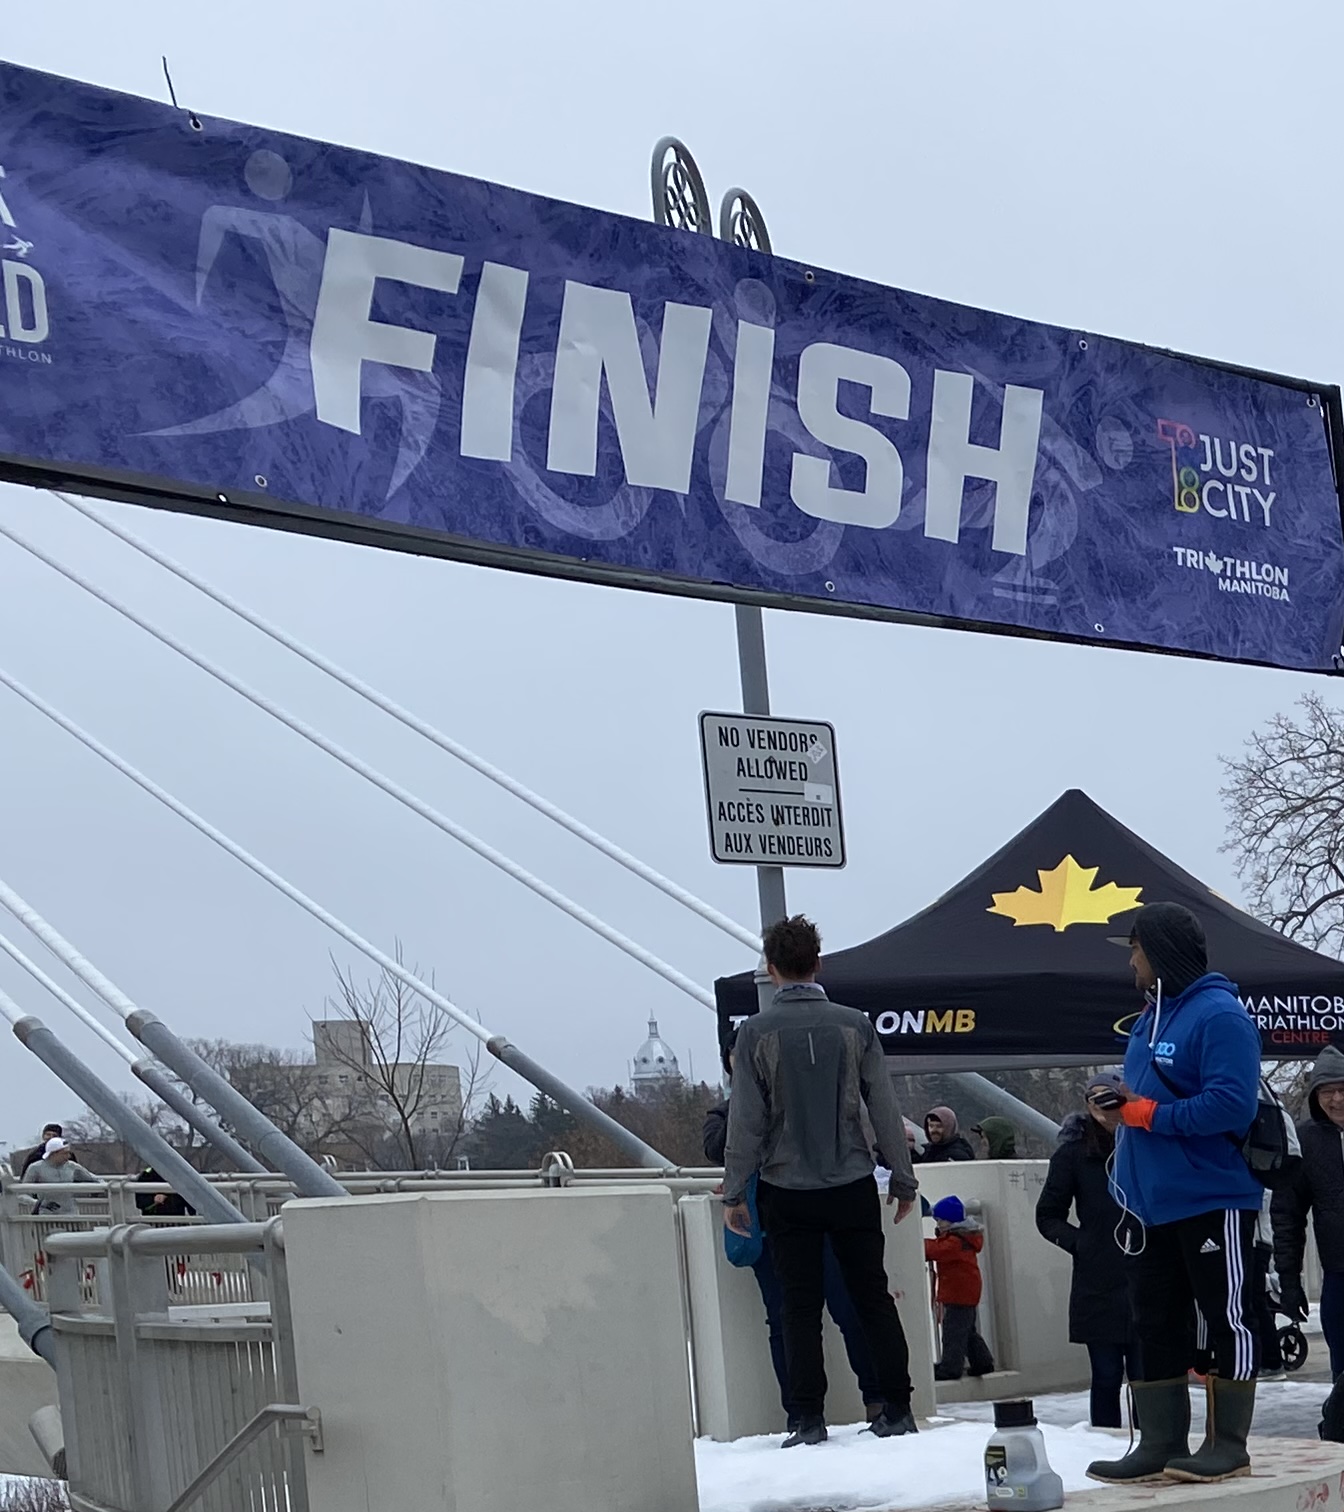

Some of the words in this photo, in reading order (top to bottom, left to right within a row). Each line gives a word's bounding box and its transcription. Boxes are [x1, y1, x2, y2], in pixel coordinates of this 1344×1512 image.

[310, 227, 1043, 556] FINISH
[1200, 434, 1274, 486] JUST
[1202, 479, 1277, 527] CITY
[1218, 577, 1290, 602] MANITOBA
[718, 726, 740, 748] NO
[736, 757, 808, 782] ALLOWED
[718, 797, 765, 824] ACCÈS
[771, 804, 833, 828] INTERDIT
[724, 832, 753, 854] AUX
[758, 834, 833, 858] VENDEURS
[1271, 1031, 1330, 1044] CENTRE
